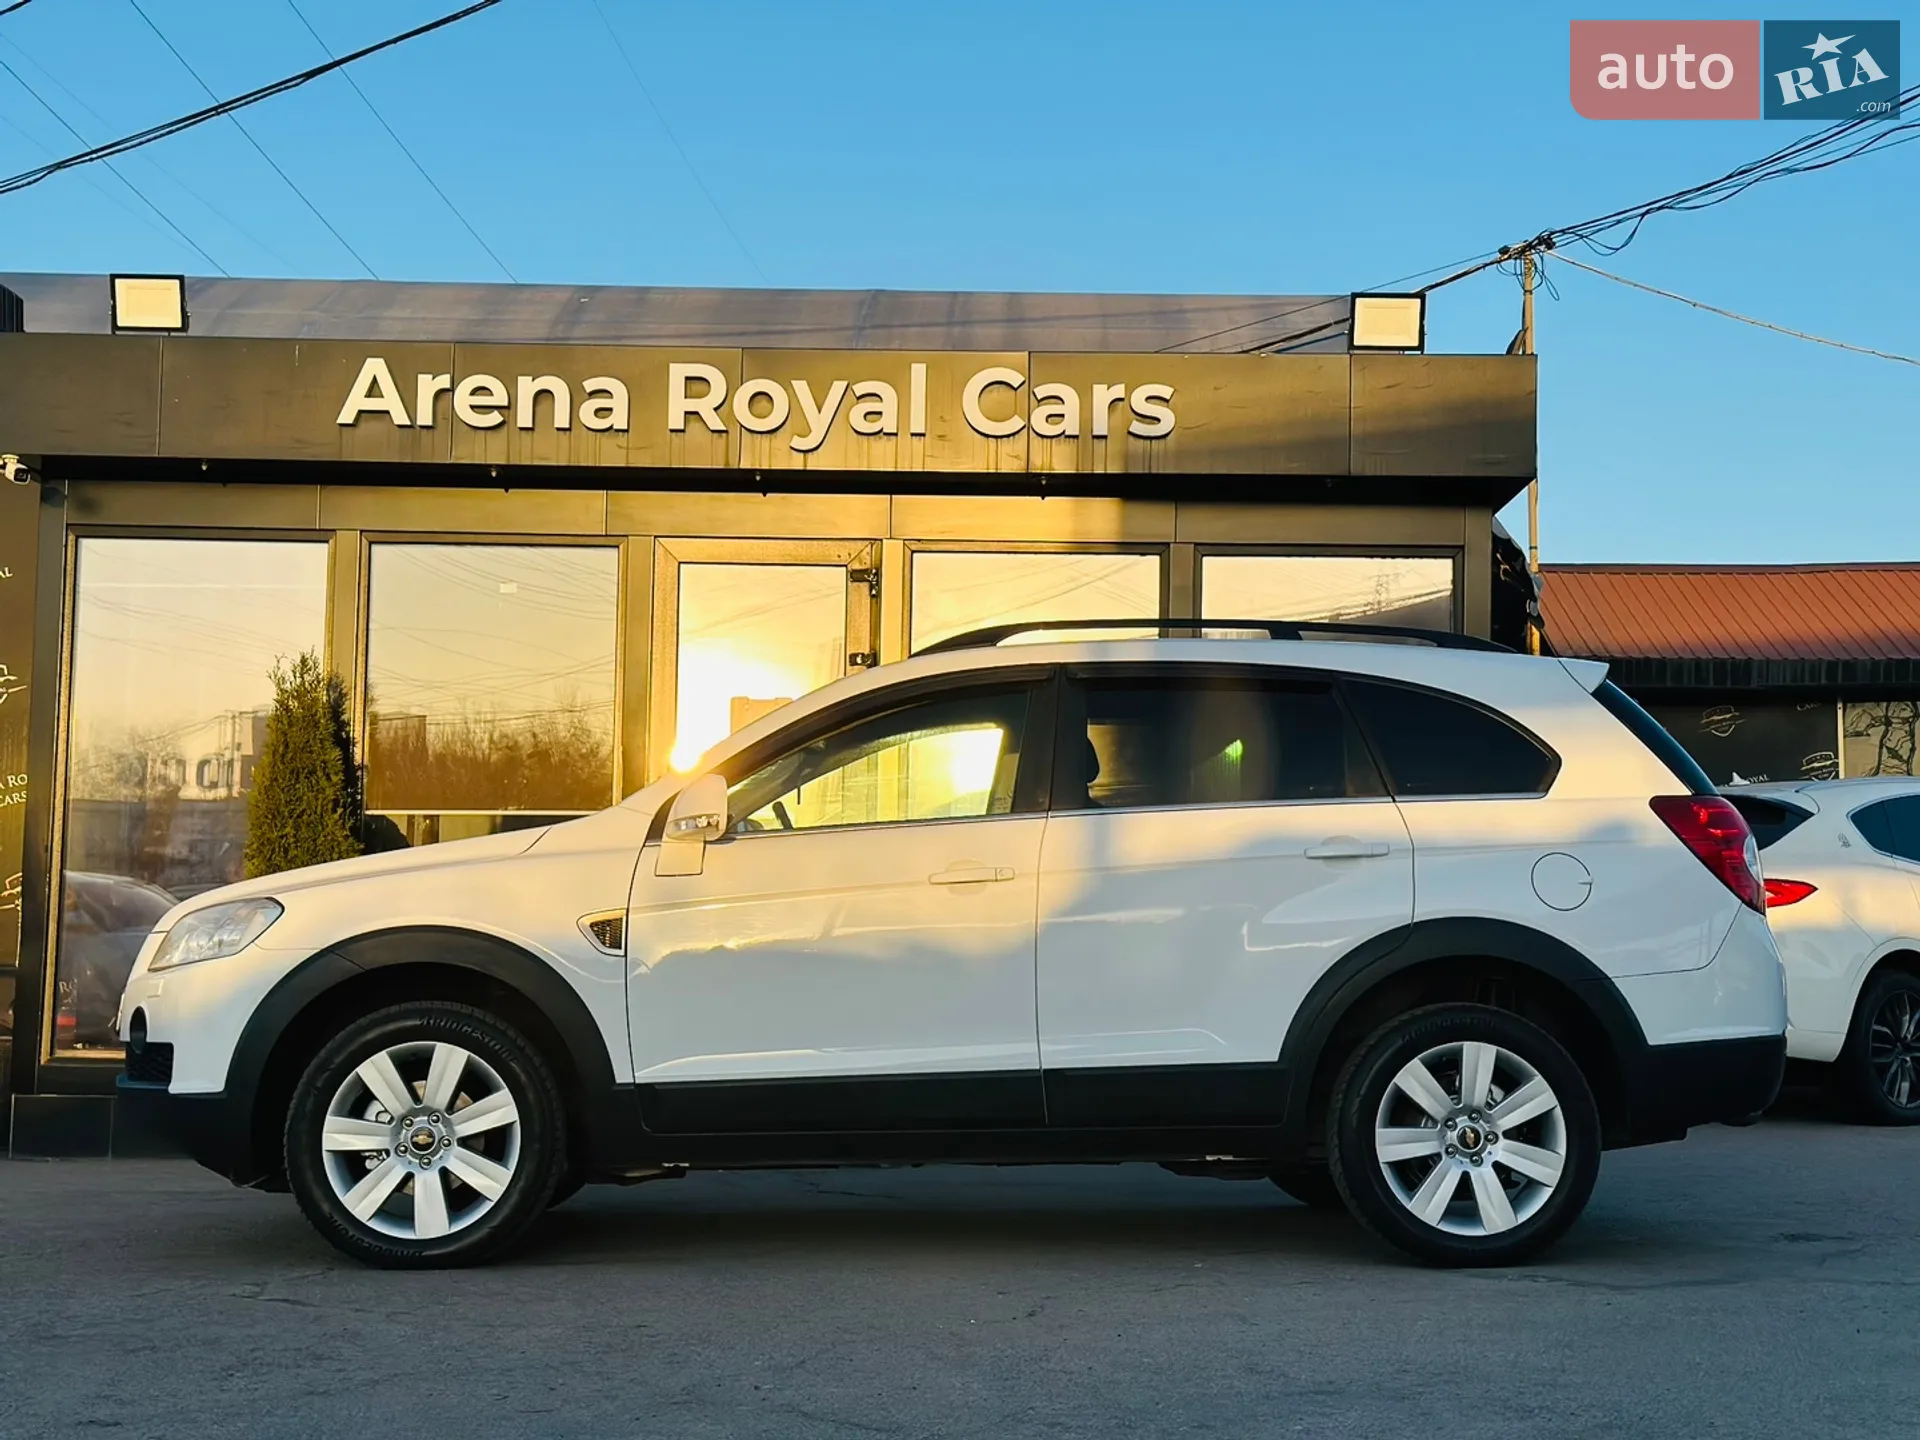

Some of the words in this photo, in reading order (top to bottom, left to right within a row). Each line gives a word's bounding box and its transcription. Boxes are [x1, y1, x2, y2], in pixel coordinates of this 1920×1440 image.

[336, 357, 630, 432] Arena
[667, 362, 928, 453] Royal
[961, 366, 1178, 440] Cars
